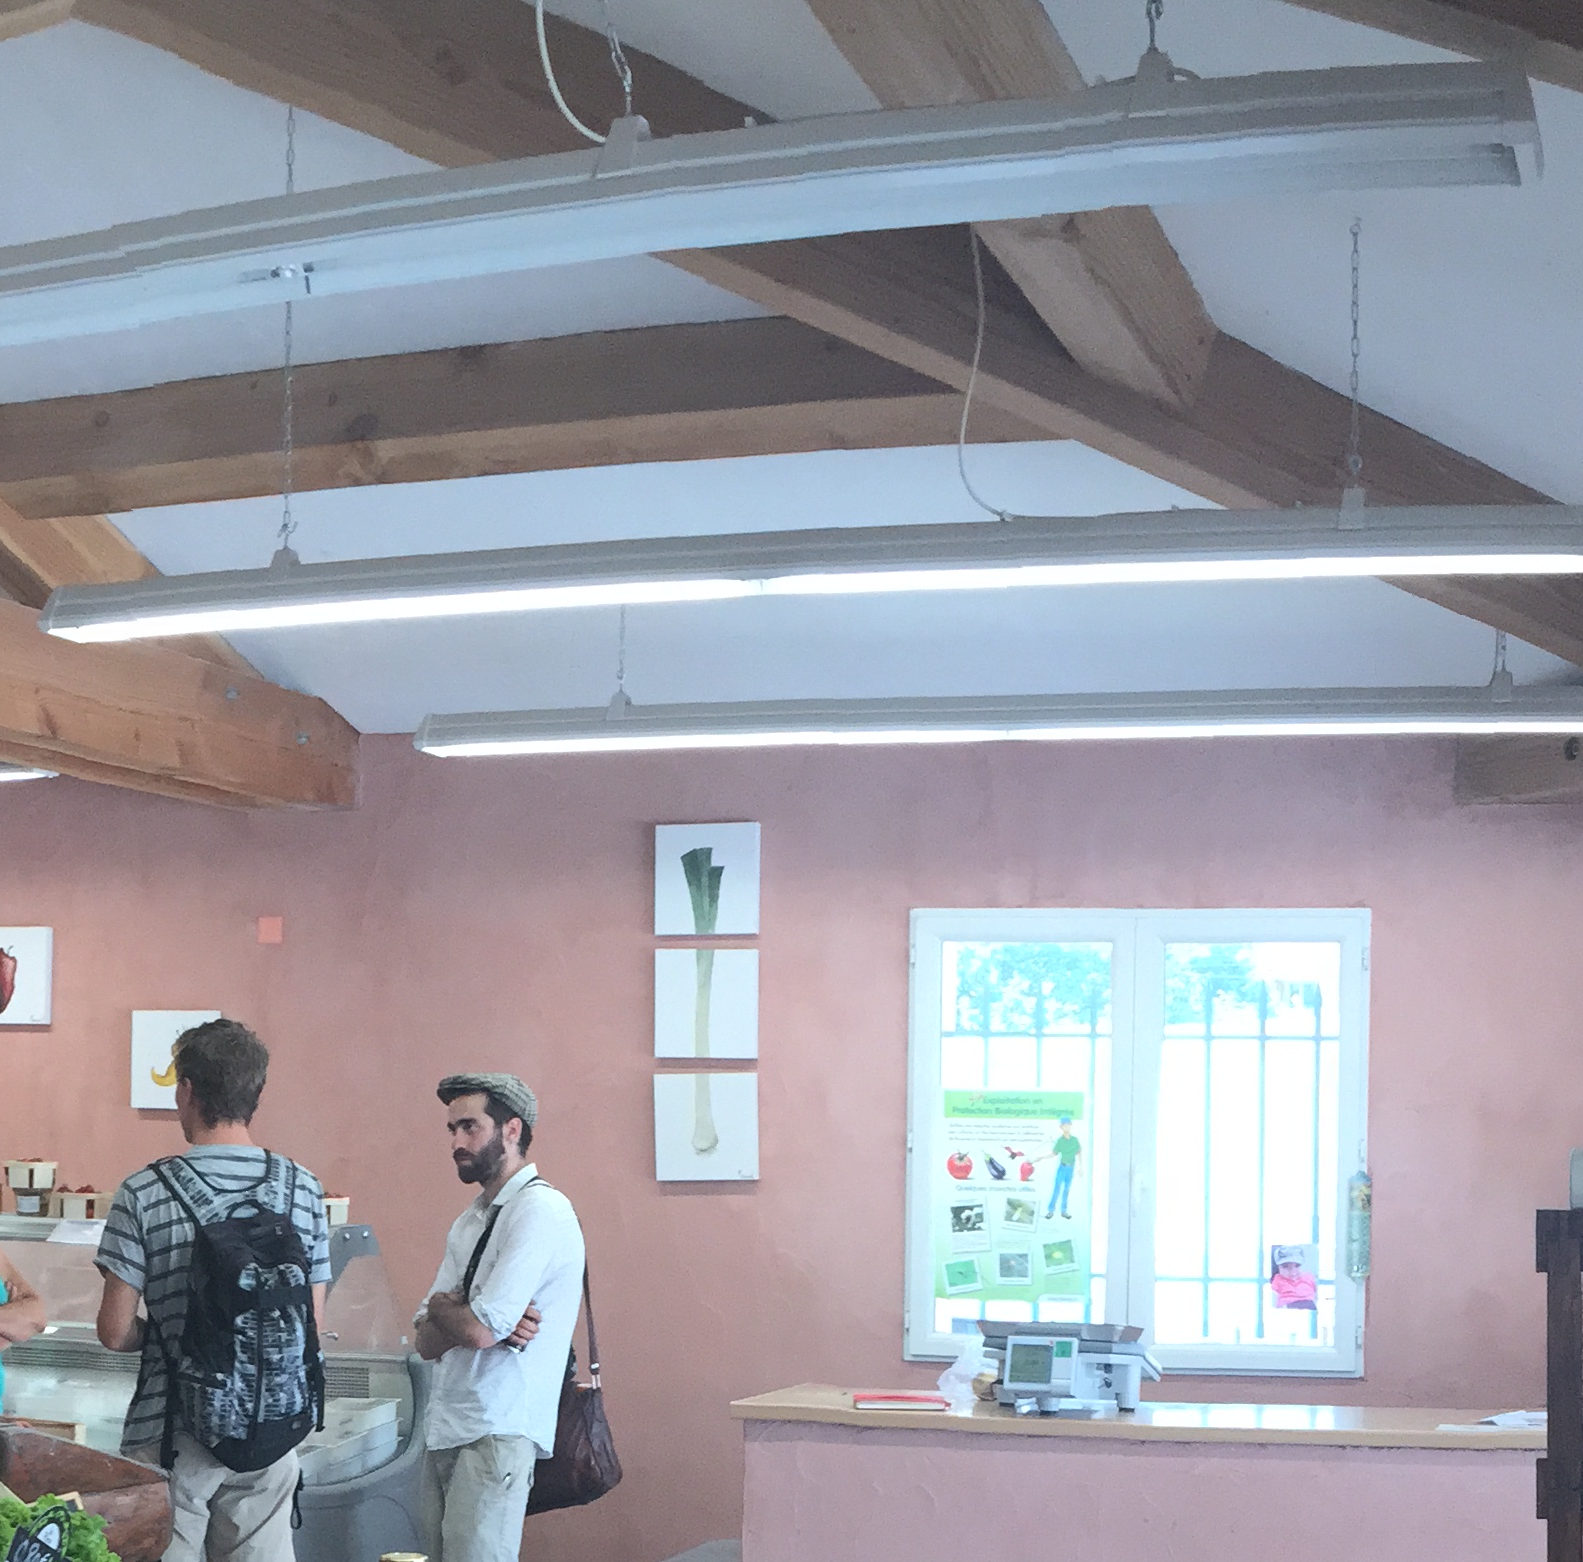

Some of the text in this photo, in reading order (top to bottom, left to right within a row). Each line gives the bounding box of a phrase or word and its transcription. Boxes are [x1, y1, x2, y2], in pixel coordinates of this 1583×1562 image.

[952, 1106, 992, 1115] Protection
[995, 1107, 1037, 1117] Biologique
[955, 1185, 987, 1194] Quelques
